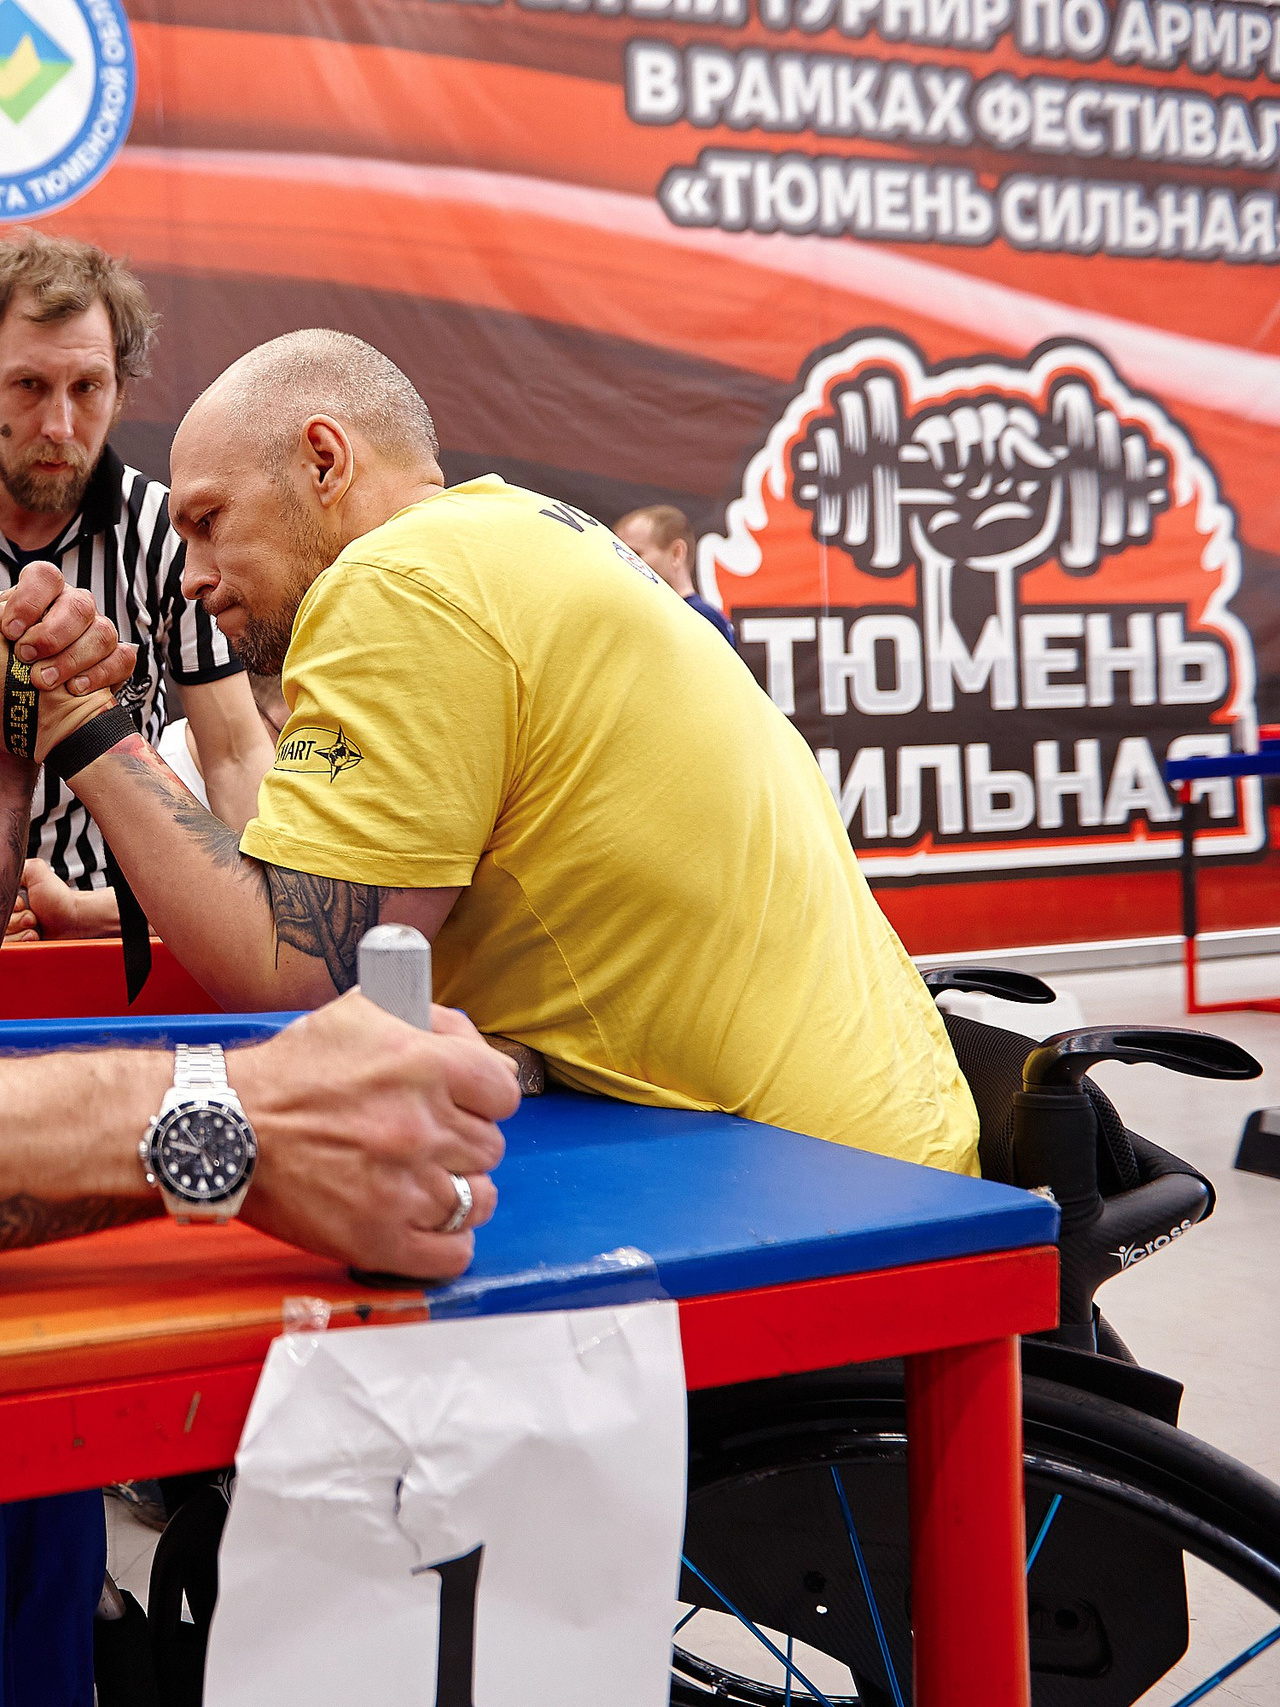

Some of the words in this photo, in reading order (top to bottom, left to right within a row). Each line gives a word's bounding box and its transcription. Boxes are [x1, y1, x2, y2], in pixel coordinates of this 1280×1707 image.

[1020, 0, 1106, 54] ПО
[1114, 0, 1280, 74] АРМР
[24, 66, 127, 205] ТЮМЕНСКОЙ
[633, 48, 680, 115] В
[691, 53, 969, 138] РАМКАХ
[669, 160, 993, 238] «ТЮМЕНЬ
[740, 612, 1228, 716] ТЮМЕНЬ
[817, 732, 1234, 838] ИЛЬНАЯ
[411, 1541, 486, 1707] 1
